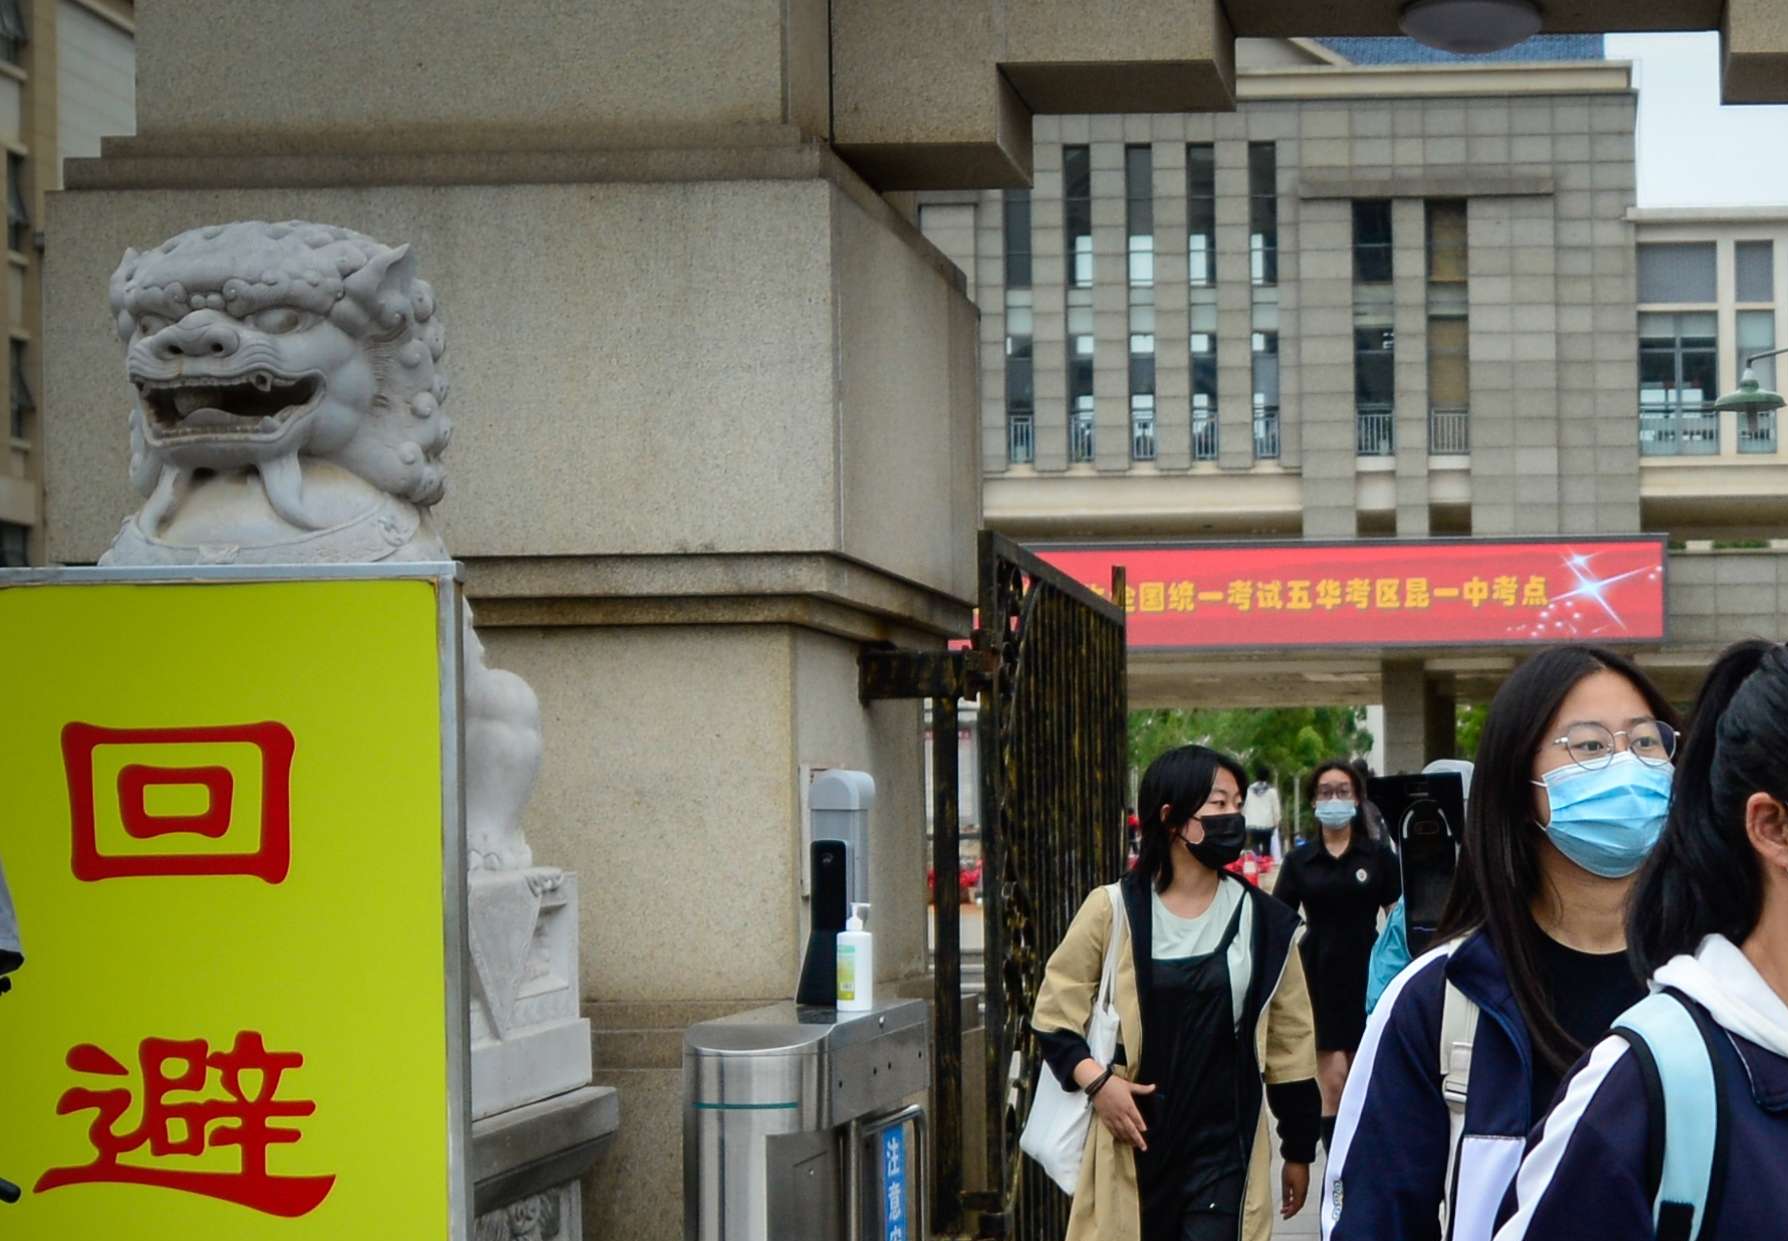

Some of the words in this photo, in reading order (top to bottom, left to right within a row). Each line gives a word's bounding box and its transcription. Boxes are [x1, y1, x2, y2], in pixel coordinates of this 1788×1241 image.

[1090, 572, 1549, 613] 国统一考试五华考区昆一中考点
